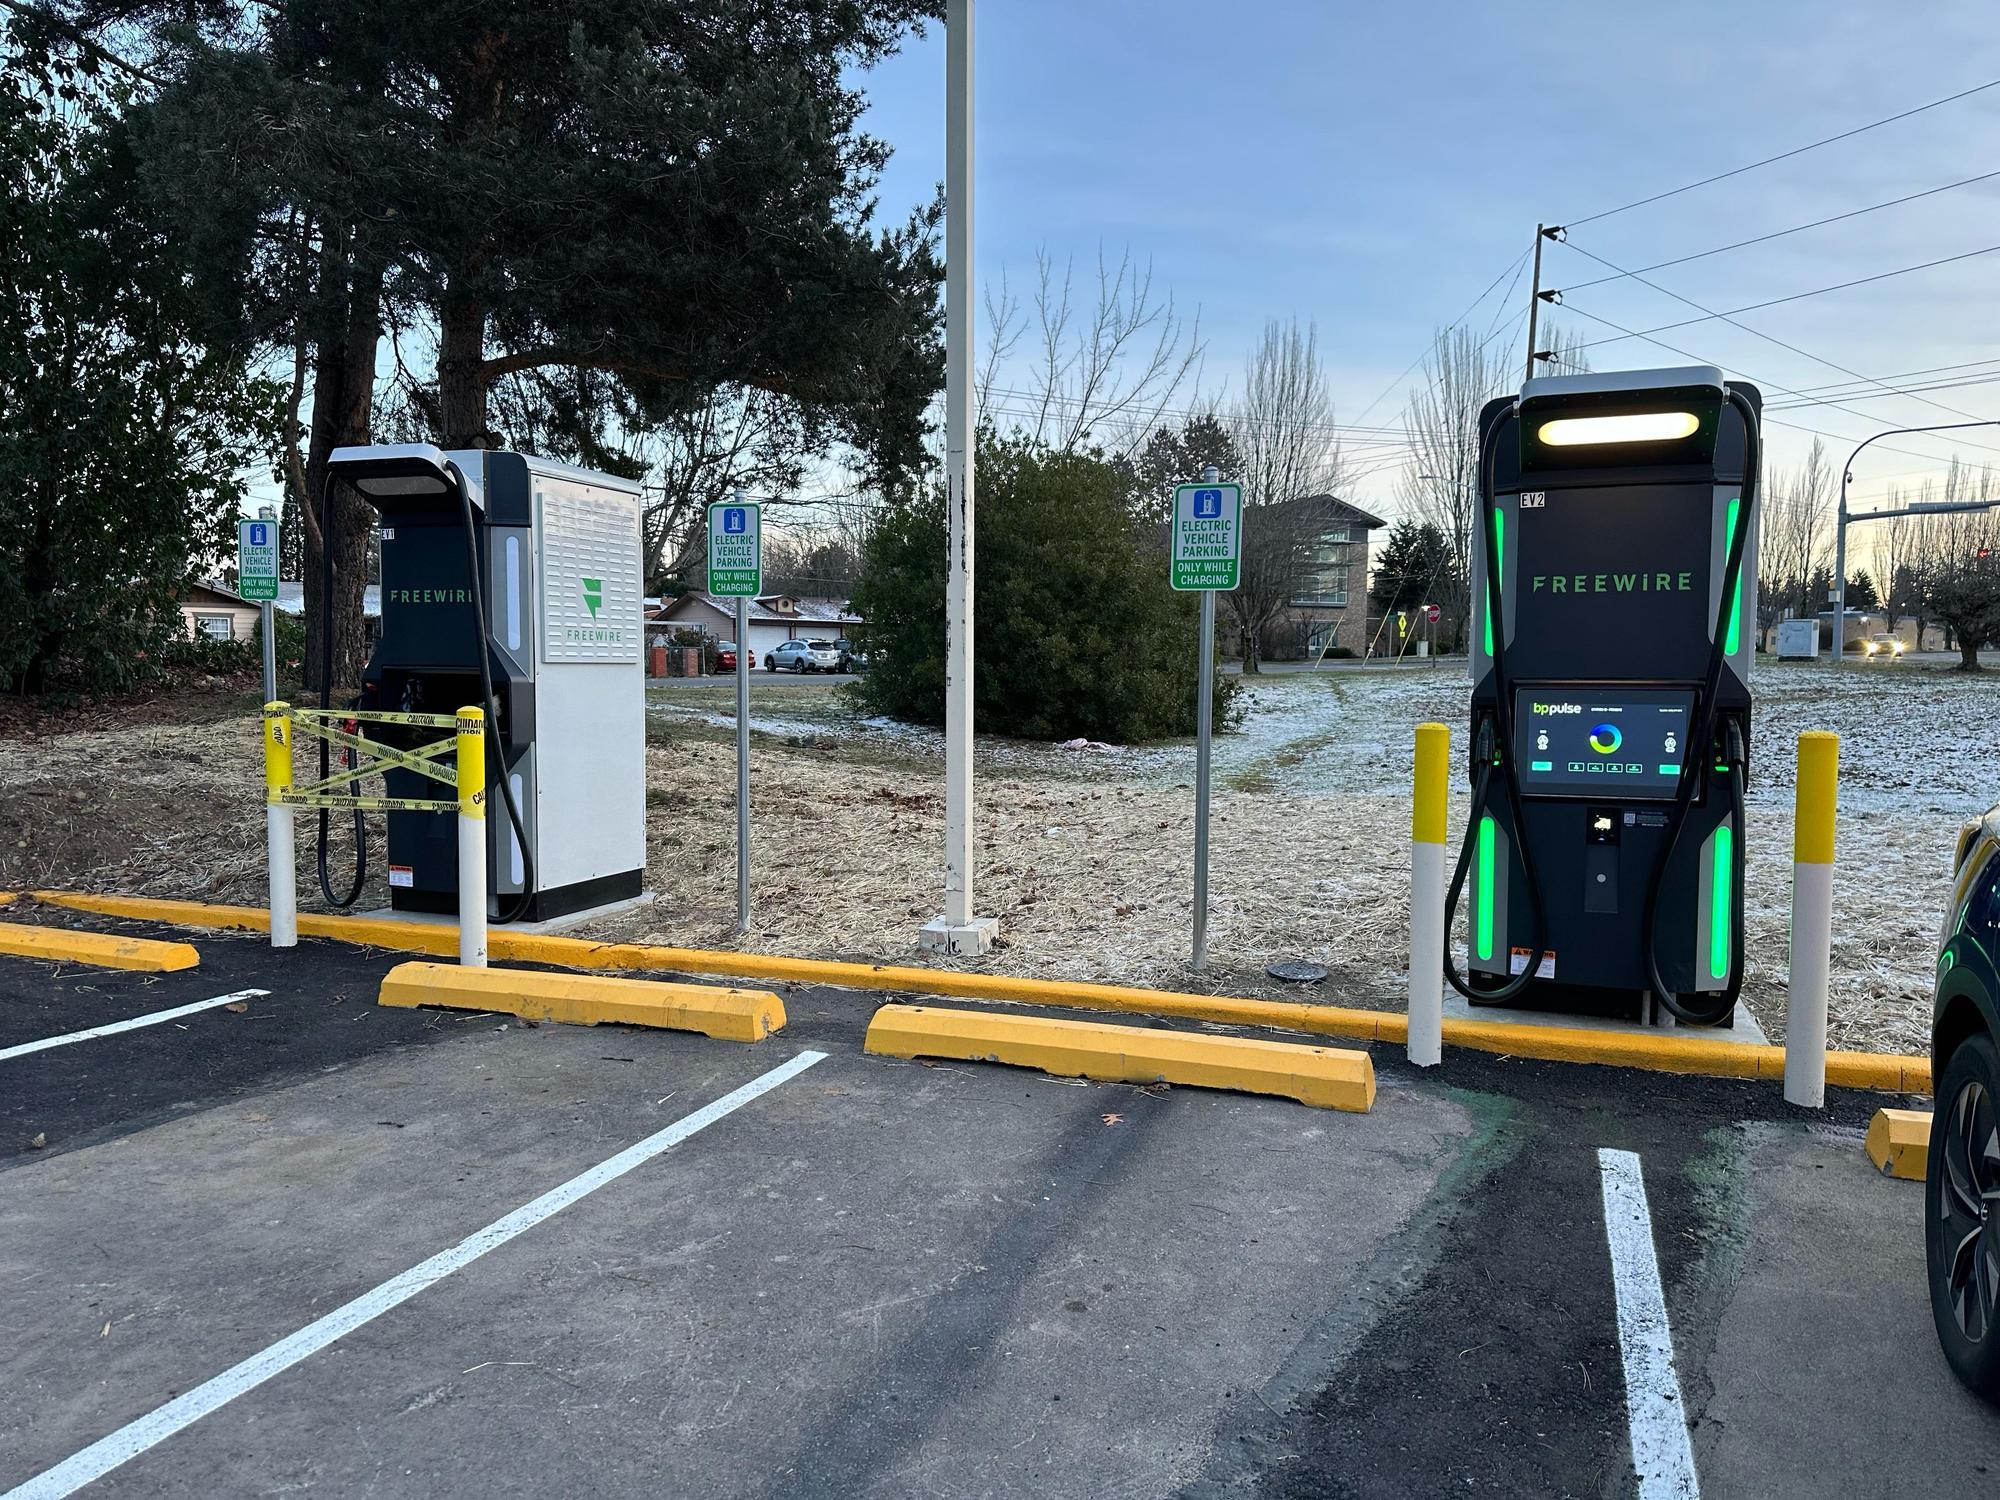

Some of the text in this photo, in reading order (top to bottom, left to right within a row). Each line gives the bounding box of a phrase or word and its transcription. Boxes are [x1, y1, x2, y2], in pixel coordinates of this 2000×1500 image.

[1521, 493, 1544, 506] EV2
[1182, 520, 1232, 532] ELECTRIC
[381, 529, 394, 539] EV1
[1184, 533, 1228, 544] VEHICLE
[715, 535, 754, 545] ELECTRIC
[244, 547, 273, 556] ELECTRIC
[717, 546, 752, 556] VEHICLE
[1182, 546, 1229, 557] PARKING
[245, 557, 272, 565] VEHICLE
[716, 558, 753, 568] PARKING
[245, 567, 272, 575] PARKING
[1178, 562, 1233, 572] ONLY WHILE
[713, 572, 756, 581] ONLY WHILE
[1180, 575, 1229, 585] CHARGING
[242, 579, 275, 587] ONLY WHILE
[716, 583, 753, 592] CHARGING
[1533, 573, 1693, 593] FREEWIRE
[244, 588, 274, 597] CHARGING
[567, 630, 621, 642] FREEWIRE
[407, 714, 436, 726] CAUTION
[456, 717, 484, 729] CUIDAD
